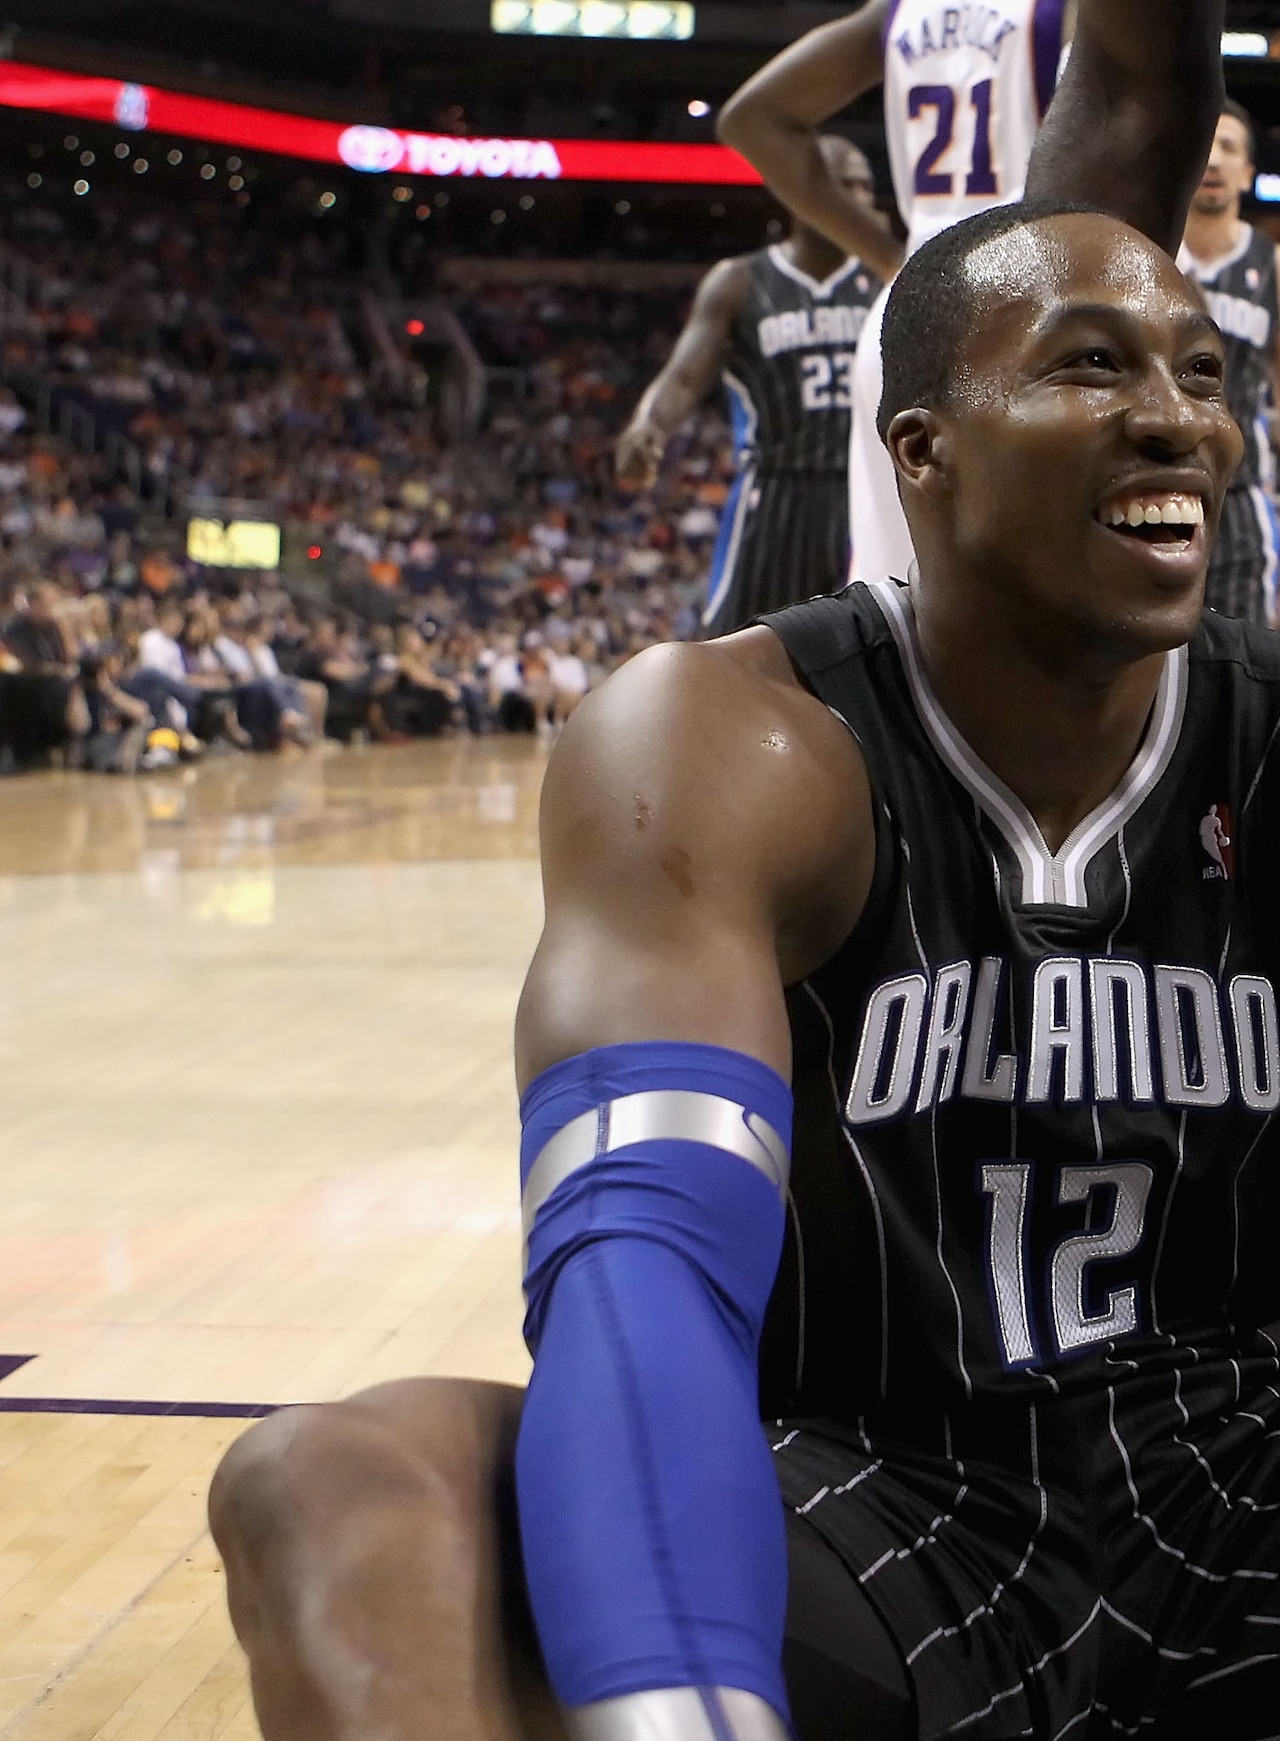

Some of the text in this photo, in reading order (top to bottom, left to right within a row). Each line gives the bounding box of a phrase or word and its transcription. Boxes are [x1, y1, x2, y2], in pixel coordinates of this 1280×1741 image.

[406, 134, 563, 179] TOYOTA
[908, 79, 998, 195] 21
[1202, 866, 1223, 880] NBA
[979, 1163, 1155, 1365] 12
